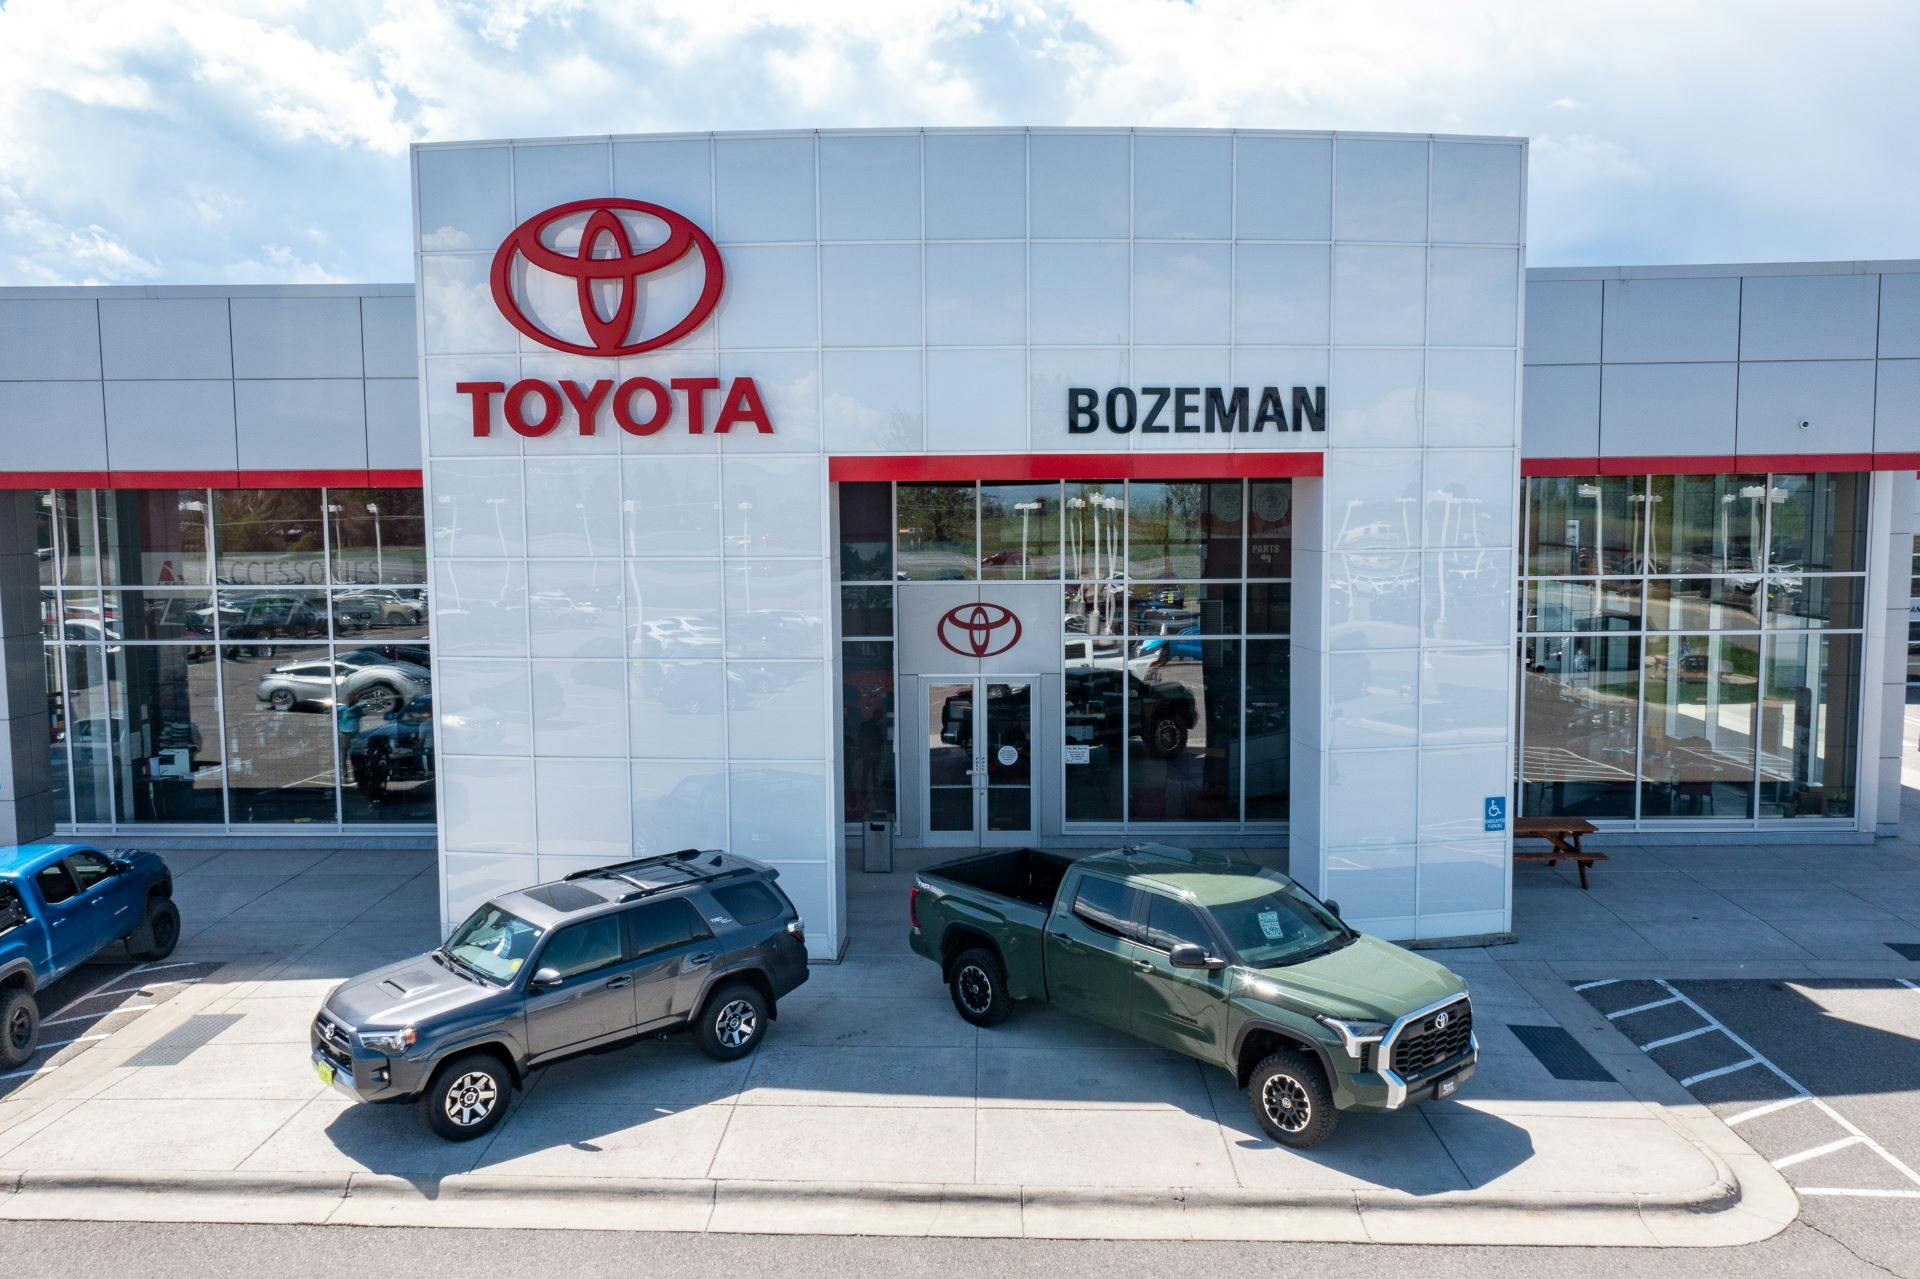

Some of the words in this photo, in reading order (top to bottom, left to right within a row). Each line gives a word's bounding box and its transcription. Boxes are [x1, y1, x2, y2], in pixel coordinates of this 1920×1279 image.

[456, 376, 775, 437] TOYOTA
[1068, 387, 1327, 434] BOZEMAN
[1252, 544, 1280, 553] PARTS
